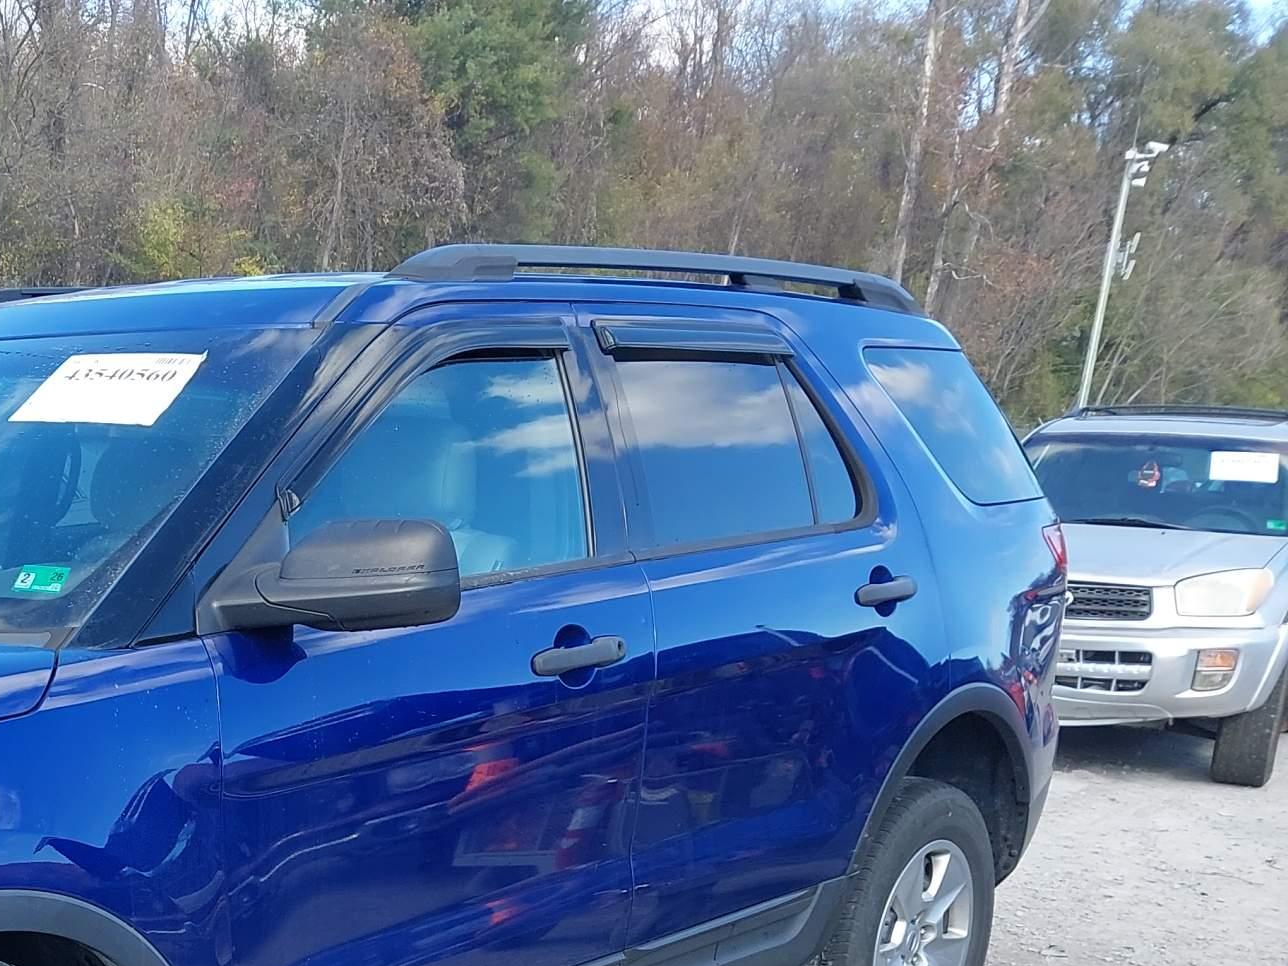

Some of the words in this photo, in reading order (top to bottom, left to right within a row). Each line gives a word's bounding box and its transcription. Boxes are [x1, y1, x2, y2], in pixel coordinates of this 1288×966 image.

[64, 368, 178, 382] 43540560
[21, 573, 31, 584] 2
[50, 571, 64, 582] 26
